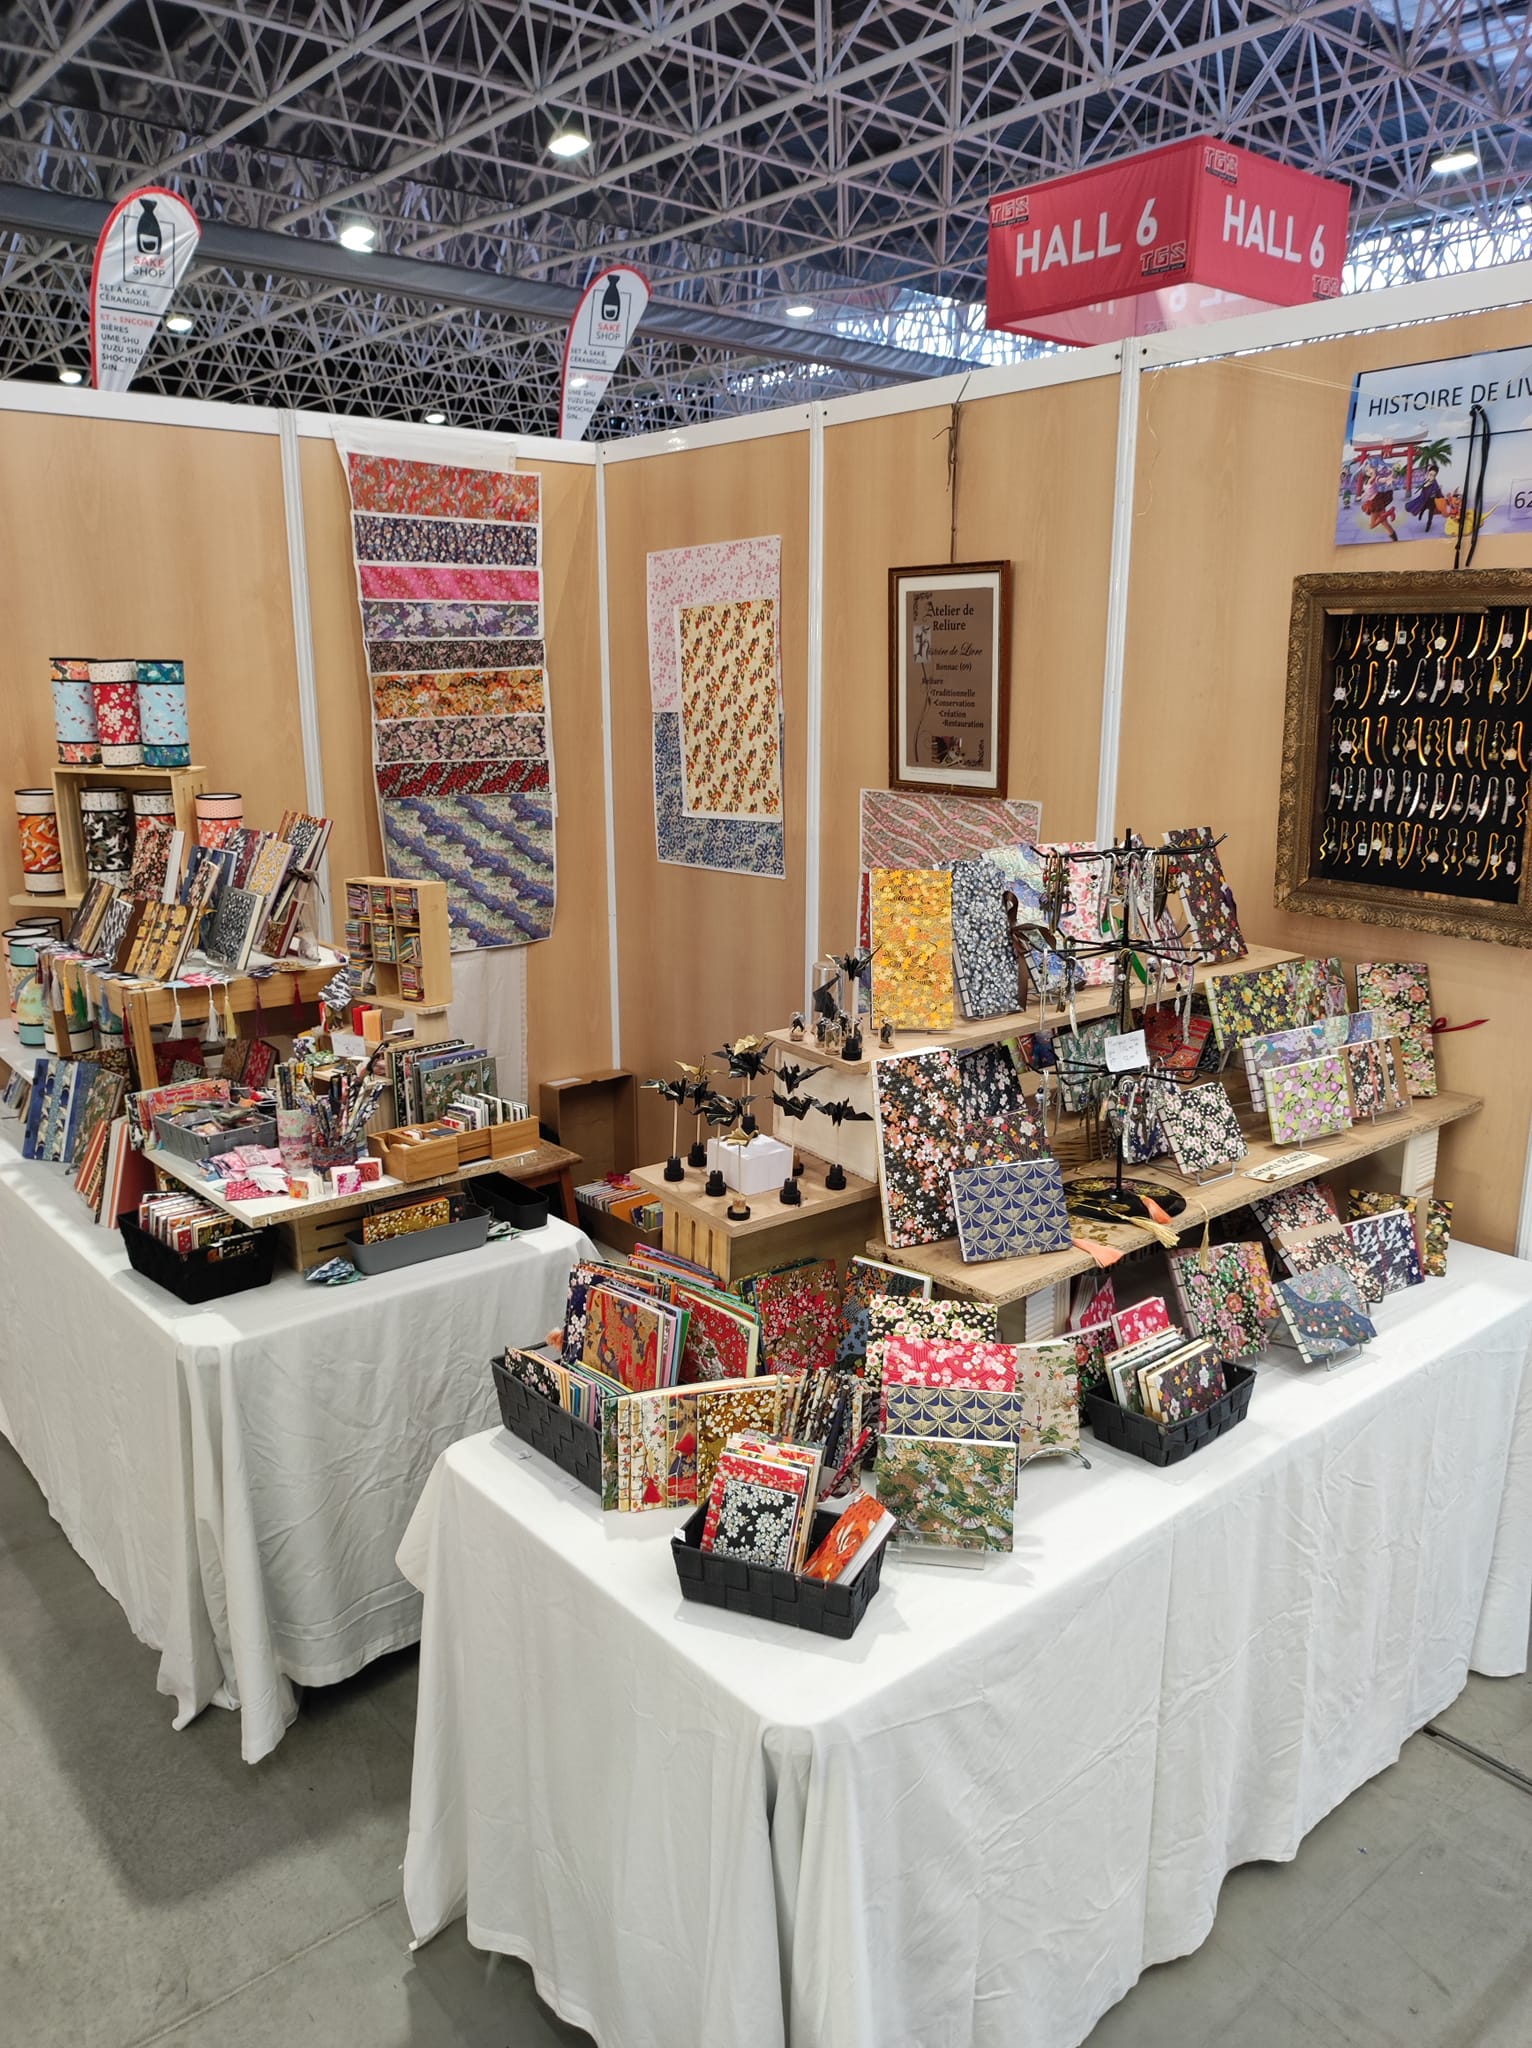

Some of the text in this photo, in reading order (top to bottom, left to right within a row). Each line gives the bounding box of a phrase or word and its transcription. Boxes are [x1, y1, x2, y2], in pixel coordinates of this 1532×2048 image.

[1204, 146, 1238, 178] TGS
[991, 194, 1029, 223] TGS
[1015, 198, 1158, 277] HALL 6
[1222, 194, 1325, 269] HALL 6
[1140, 240, 1187, 272] TGS
[132, 265, 166, 278] SHOP
[100, 333, 140, 346] UME SHU
[595, 331, 621, 341] SHOP
[101, 343, 144, 356] YUZU SHU
[101, 352, 138, 365] SHOCHU
[1368, 387, 1463, 417] HISTOIRE
[1471, 382, 1499, 404] DE
[925, 601, 975, 618] Atelier de
[932, 619, 967, 632] Reliure
[949, 645, 958, 657] de
[943, 719, 985, 729] Restauration
